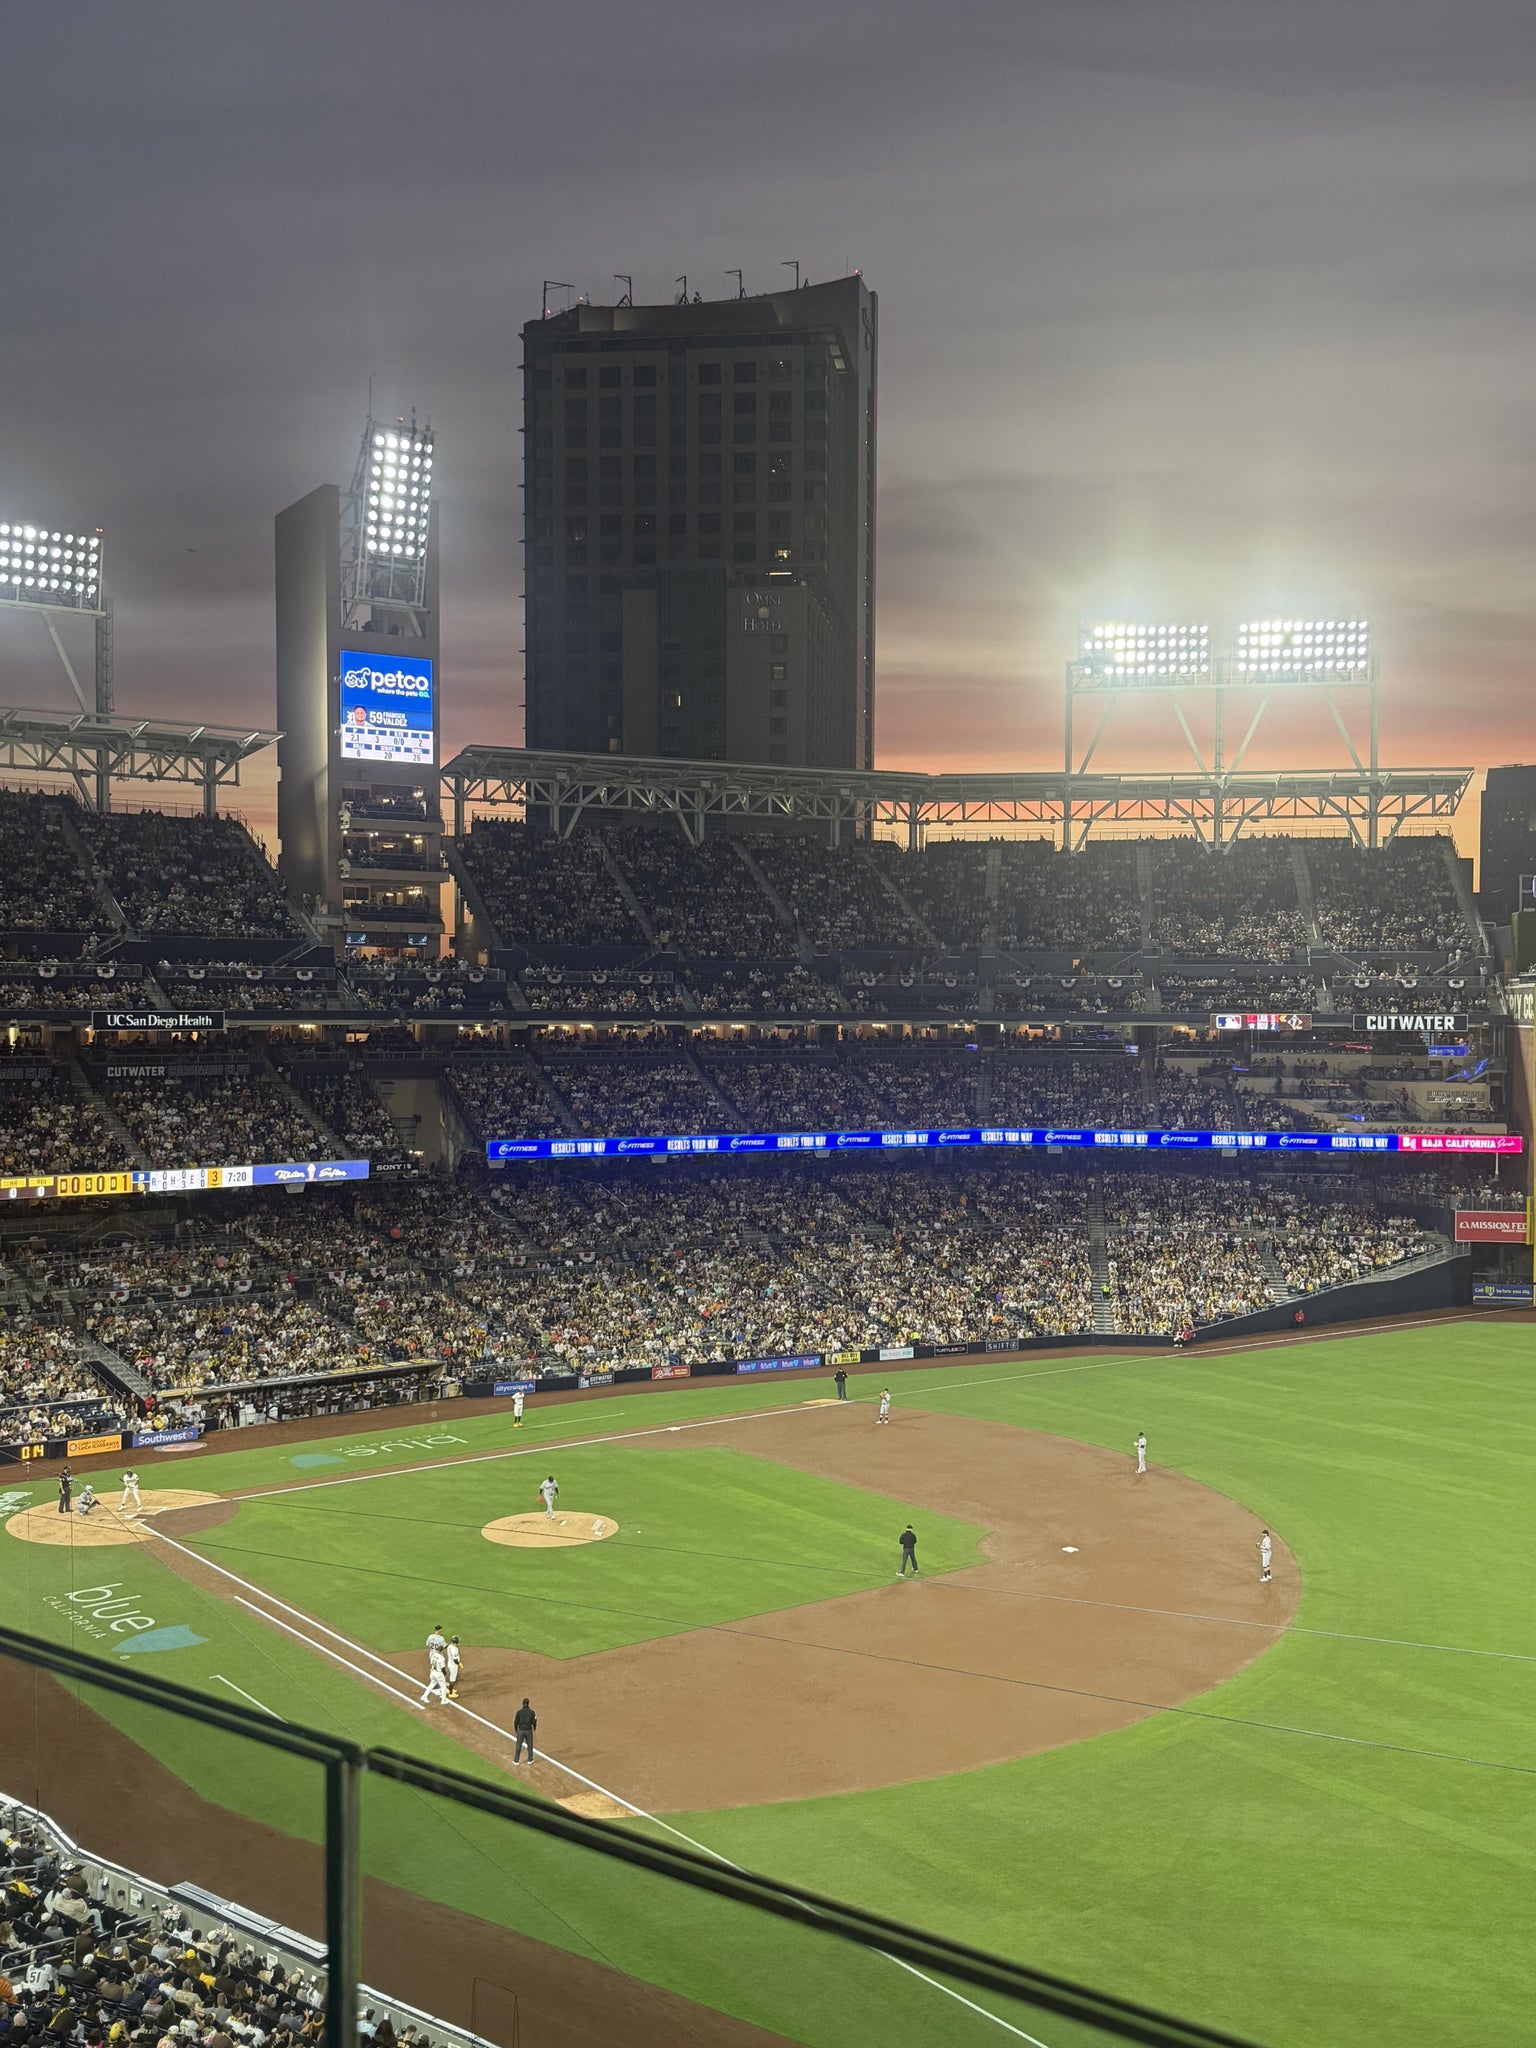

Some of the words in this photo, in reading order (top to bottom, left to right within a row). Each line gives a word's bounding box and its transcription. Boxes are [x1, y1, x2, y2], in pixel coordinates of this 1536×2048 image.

[746, 592, 781, 605] OMNI
[371, 671, 429, 691] petco
[369, 711, 383, 724] 59
[107, 1014, 126, 1027] UC
[126, 1014, 147, 1026] San
[148, 1014, 178, 1029] Diego
[179, 1014, 212, 1026] Health
[1366, 1015, 1455, 1030] CUTWATER
[107, 1065, 166, 1077] CUTWATER
[1421, 1139, 1443, 1148] BAJA
[1445, 1138, 1496, 1149] CALIFORNIA
[376, 1164, 403, 1172] SONY
[228, 1171, 247, 1183] 7:20
[1470, 1221, 1510, 1230] MISSION
[1485, 1286, 1495, 1294] 811
[138, 1431, 187, 1445] Southwest
[64, 1582, 156, 1632] blue
[43, 1595, 108, 1639] CALIFORNIA
[30, 1971, 42, 1984] 51
